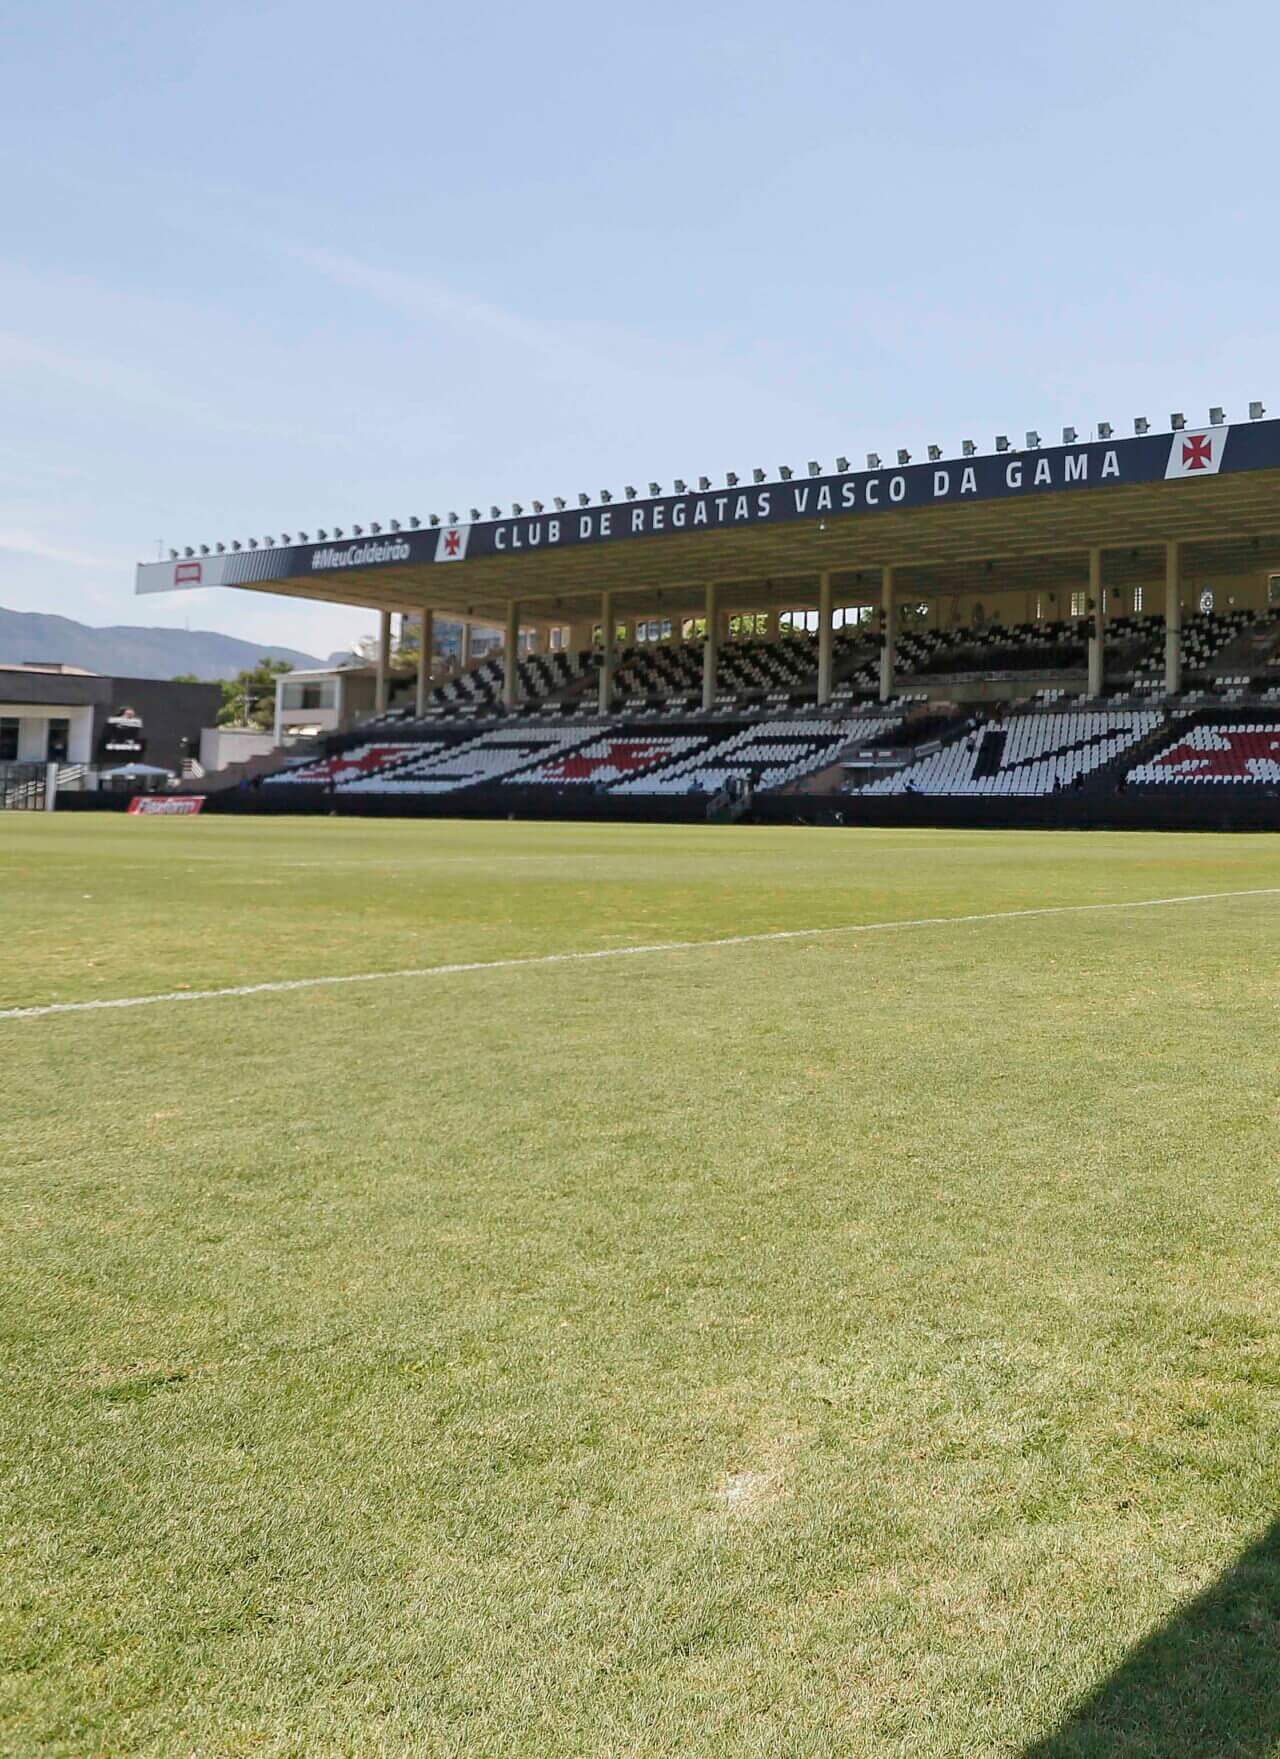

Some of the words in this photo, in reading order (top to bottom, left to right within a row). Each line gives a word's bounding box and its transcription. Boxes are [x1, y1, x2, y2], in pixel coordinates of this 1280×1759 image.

[494, 520, 561, 549] CLUB
[579, 513, 612, 538] DE
[631, 492, 771, 532] REGATAS
[794, 476, 906, 513] VASCO
[933, 467, 977, 497] DA
[1005, 450, 1121, 488] GAMA
[311, 538, 411, 570] #MeuCaldeirão
